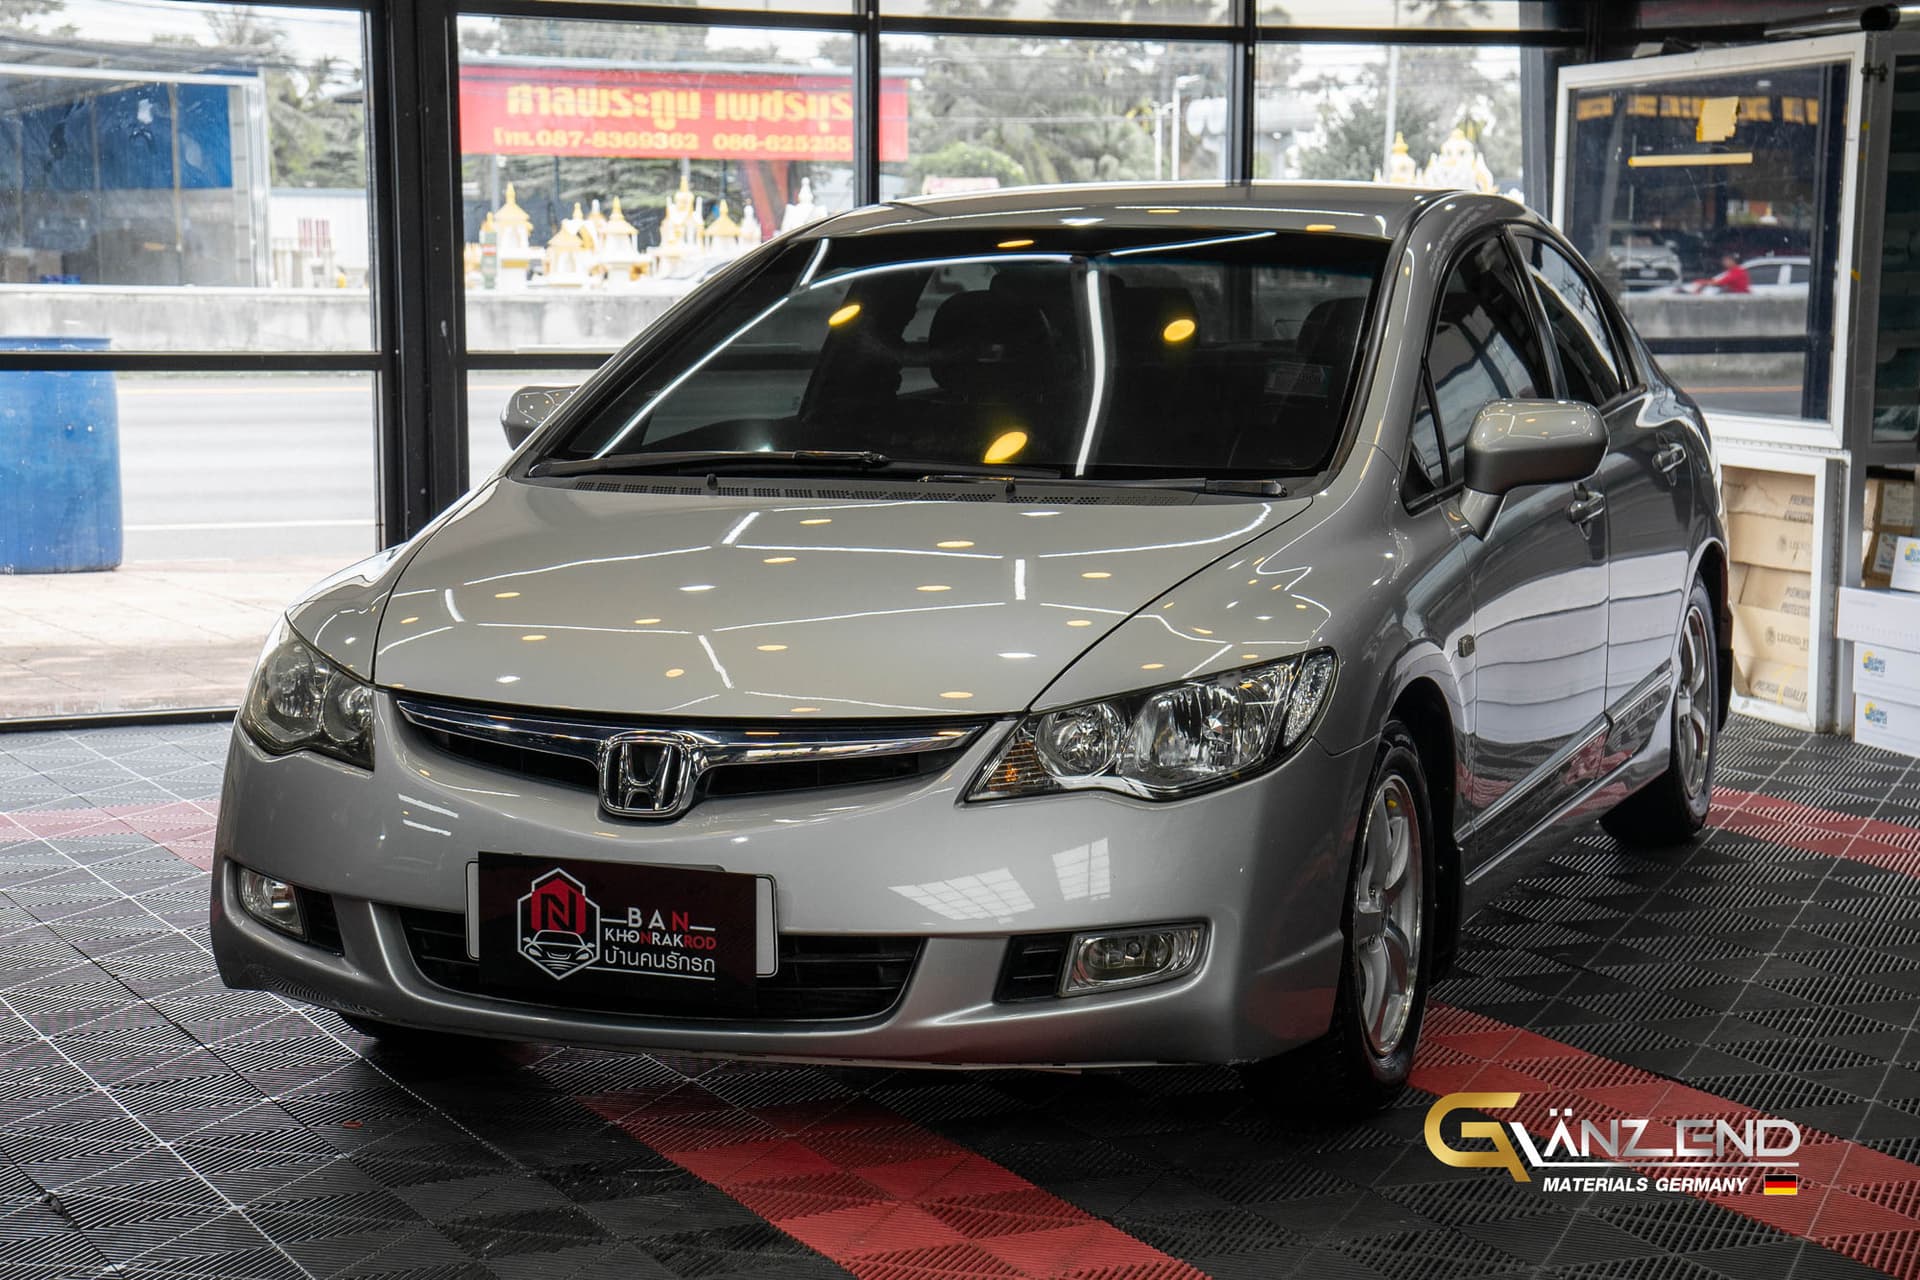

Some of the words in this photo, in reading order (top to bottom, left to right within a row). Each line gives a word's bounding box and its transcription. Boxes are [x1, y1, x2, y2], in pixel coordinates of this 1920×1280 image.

[604, 946, 716, 973] บ้านคนรักรถ
